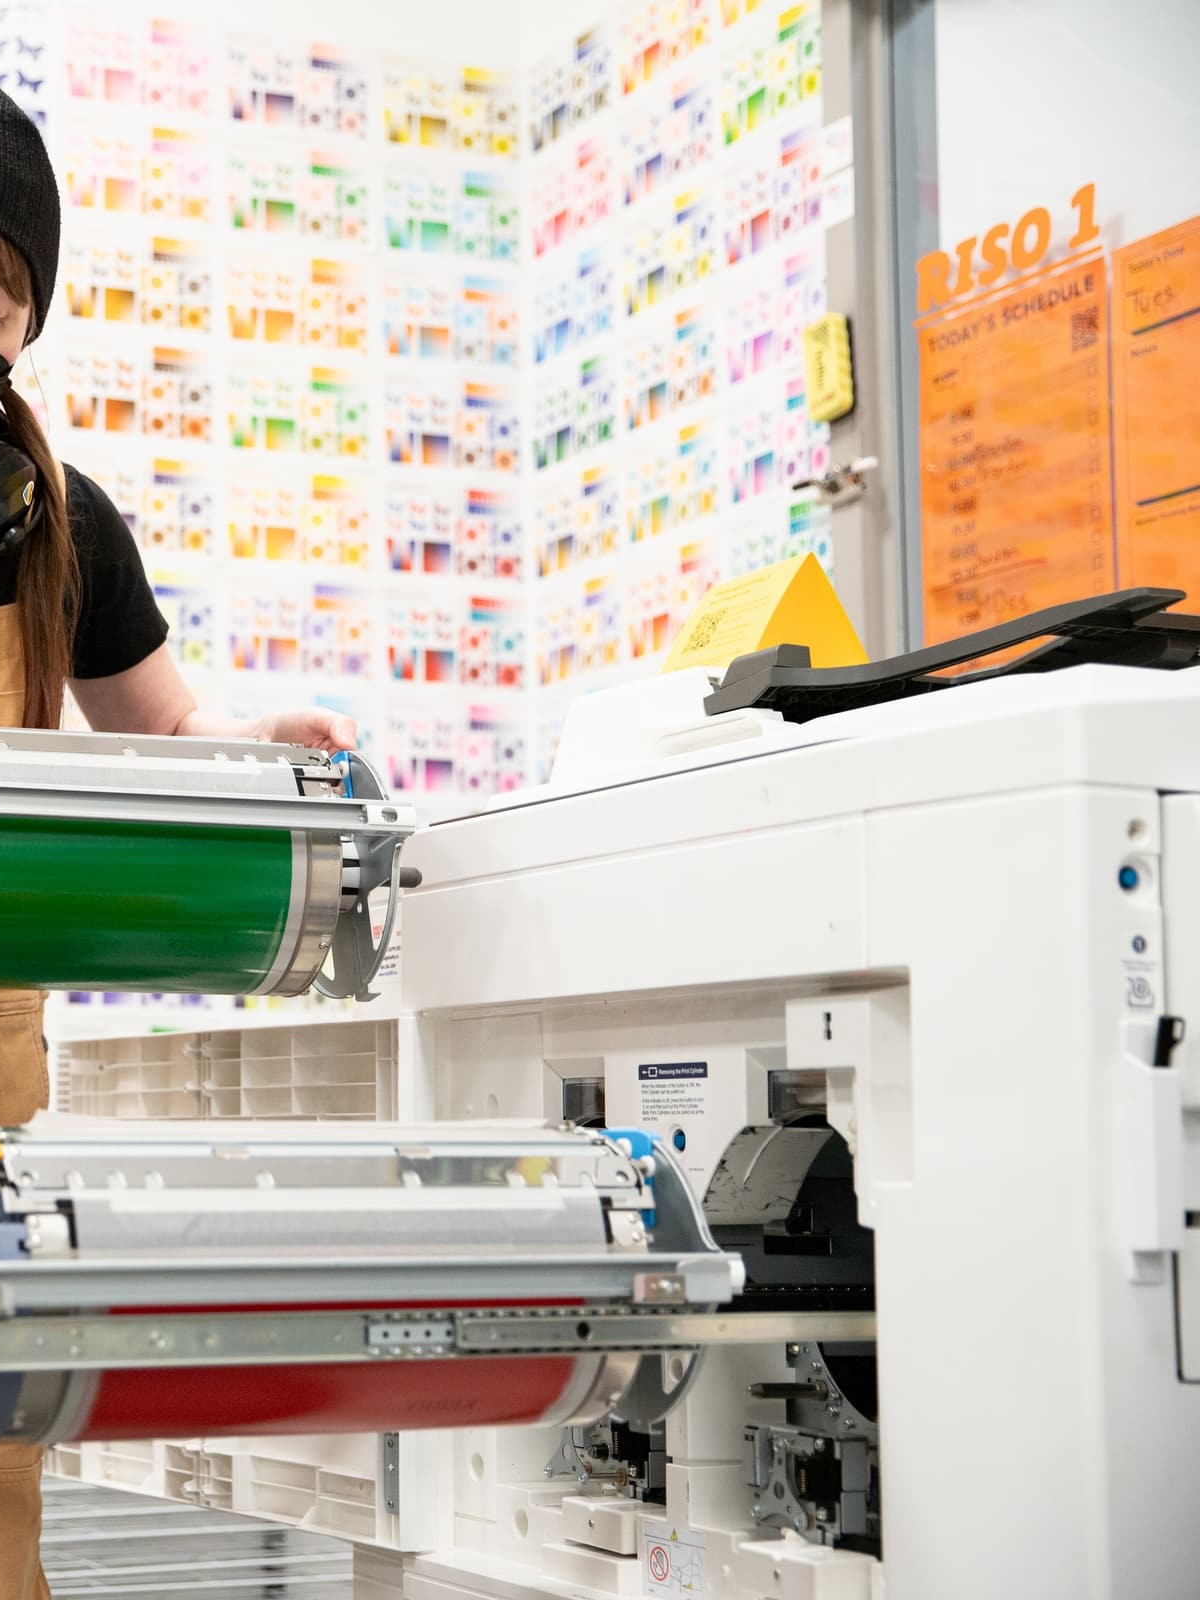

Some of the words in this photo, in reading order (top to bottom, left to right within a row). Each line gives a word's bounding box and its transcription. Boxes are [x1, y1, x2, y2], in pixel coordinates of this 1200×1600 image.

[915, 207, 1052, 313] RISO
[1069, 182, 1101, 249] 1
[928, 312, 997, 353] TODAY'S
[1000, 273, 1096, 327] SCHEDULE
[690, 1067, 704, 1075] Cylinder
